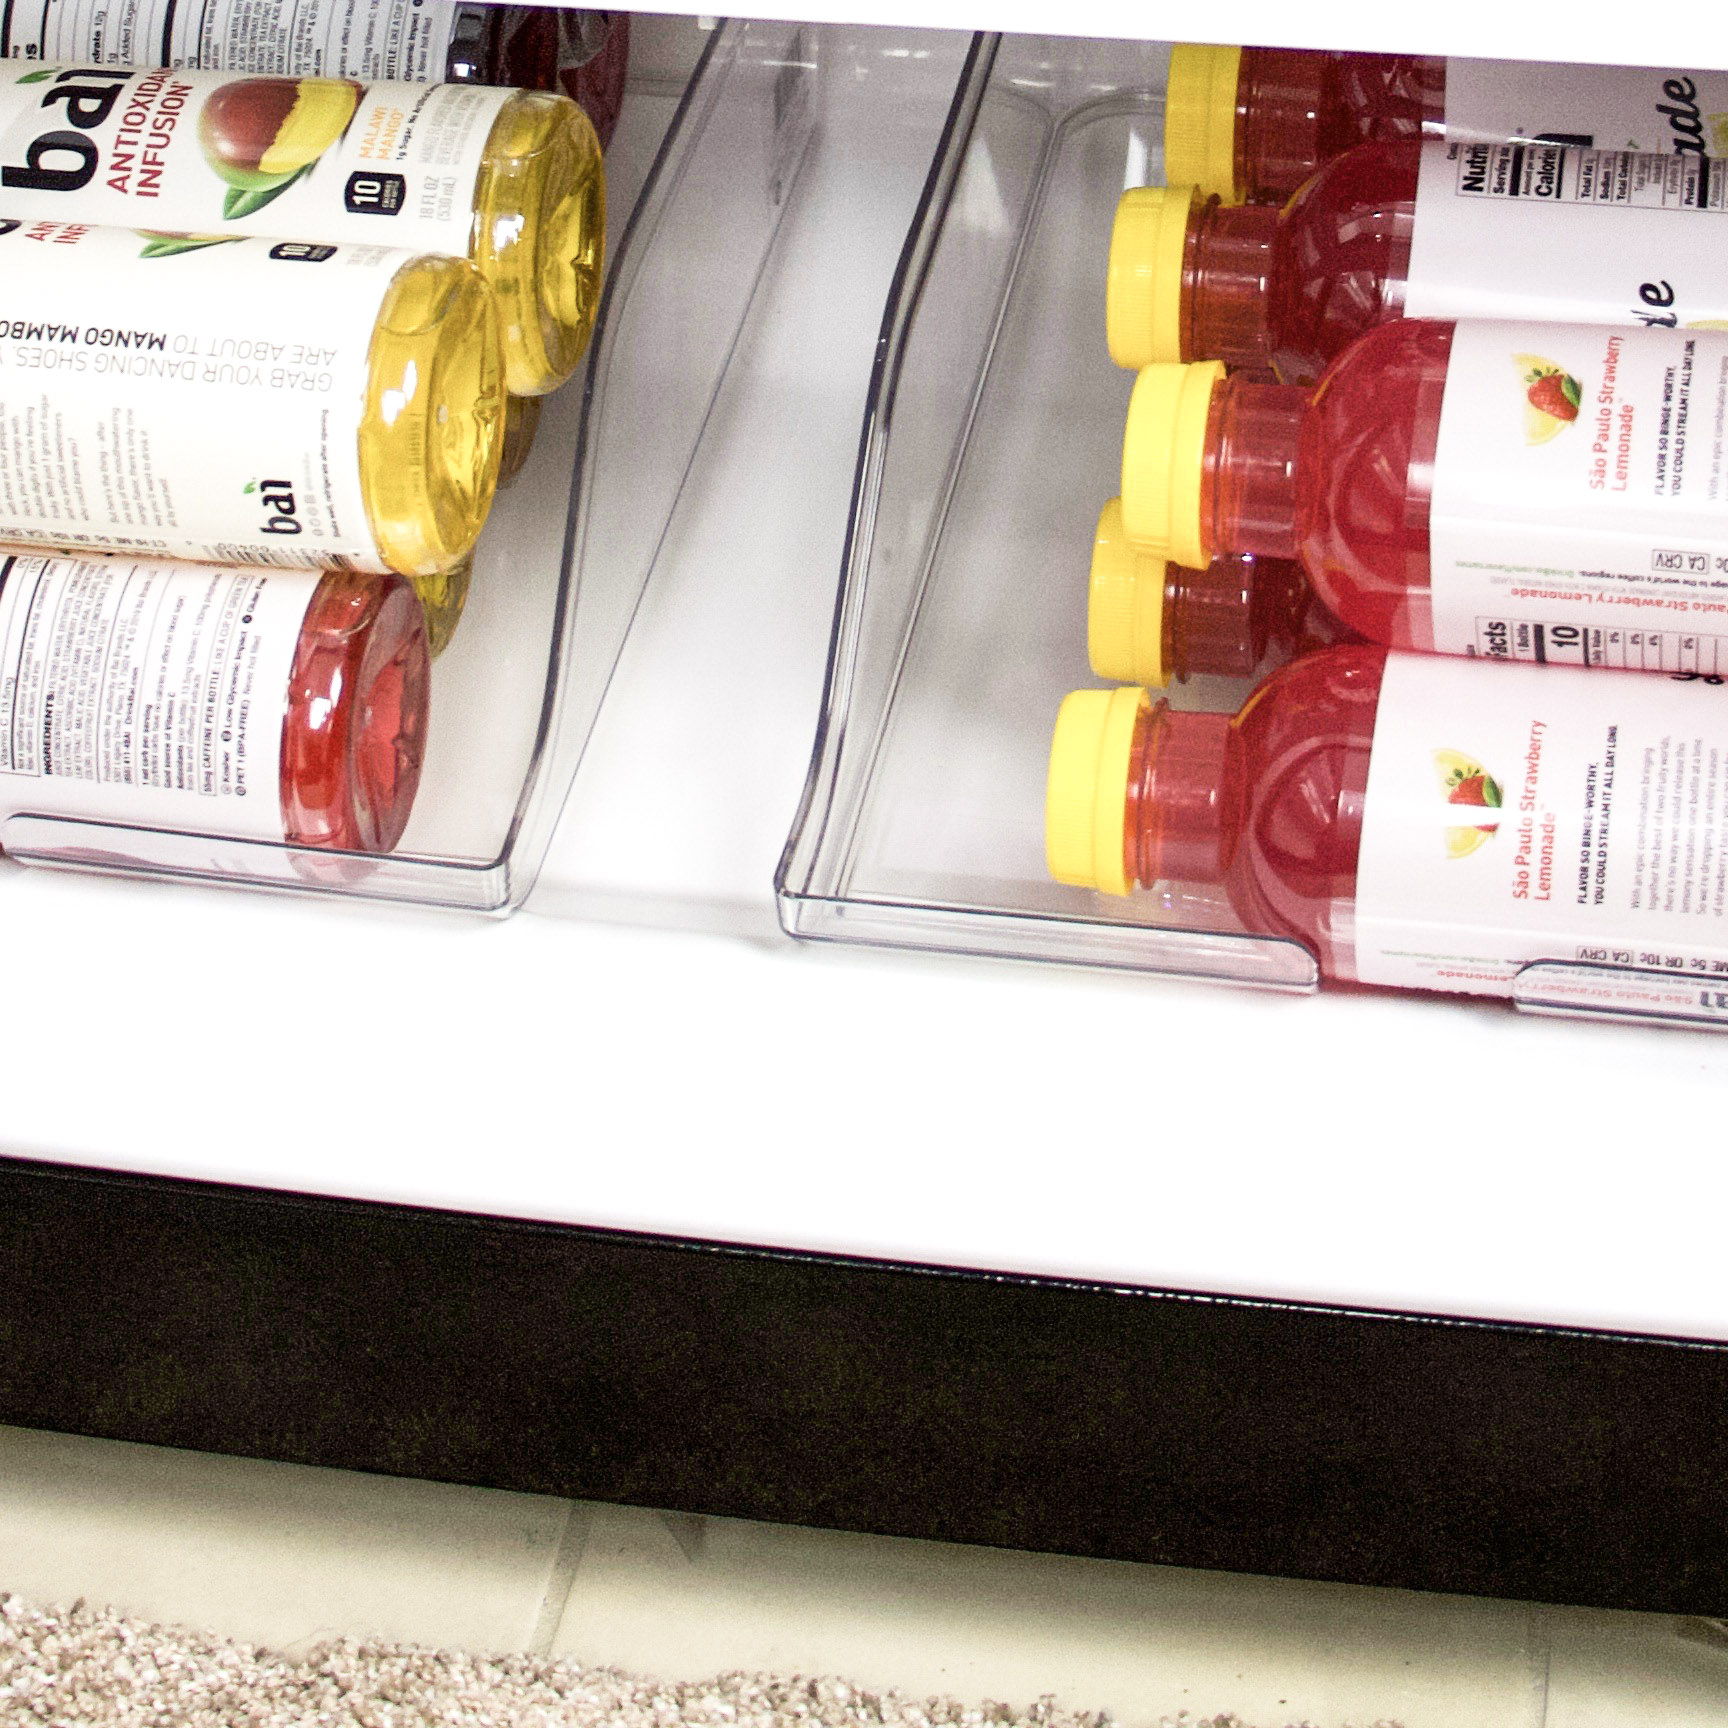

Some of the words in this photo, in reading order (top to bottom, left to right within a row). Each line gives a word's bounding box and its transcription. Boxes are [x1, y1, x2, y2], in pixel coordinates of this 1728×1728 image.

[0, 68, 136, 192] bai
[360, 106, 387, 159] MALAWI
[352, 180, 382, 205] 10
[278, 244, 312, 258] 10
[84, 326, 167, 352] MANGO
[172, 334, 198, 356] TO
[206, 337, 286, 362] ABOUT
[13, 345, 88, 372] SHOES.
[94, 353, 196, 381] DANCING
[290, 344, 338, 367] ARE
[202, 363, 263, 386] YOUR
[270, 368, 333, 392] GRAB
[1598, 335, 1624, 405] Strawberry
[1593, 407, 1611, 453] Paulo
[1677, 397, 1689, 437] STREAM
[1659, 437, 1668, 449] SO
[1672, 437, 1685, 473] COULD
[1589, 457, 1606, 490] São
[1655, 453, 1667, 496] FLAVOR
[1671, 475, 1682, 497] YOU
[258, 479, 303, 535] bai
[1656, 552, 1683, 570] CRV
[1688, 556, 1706, 572] CA
[1596, 591, 1689, 612] Strawberry
[1519, 720, 1547, 813] Strawberry
[1603, 770, 1614, 790] ALL
[1597, 802, 1611, 848] STREAM
[1514, 816, 1533, 867] Paulo
[1580, 849, 1591, 863] SO
[1595, 849, 1607, 880] COULD
[1512, 869, 1530, 900] São
[1577, 864, 1589, 905] FLAVOR
[1593, 880, 1604, 906] YOU
